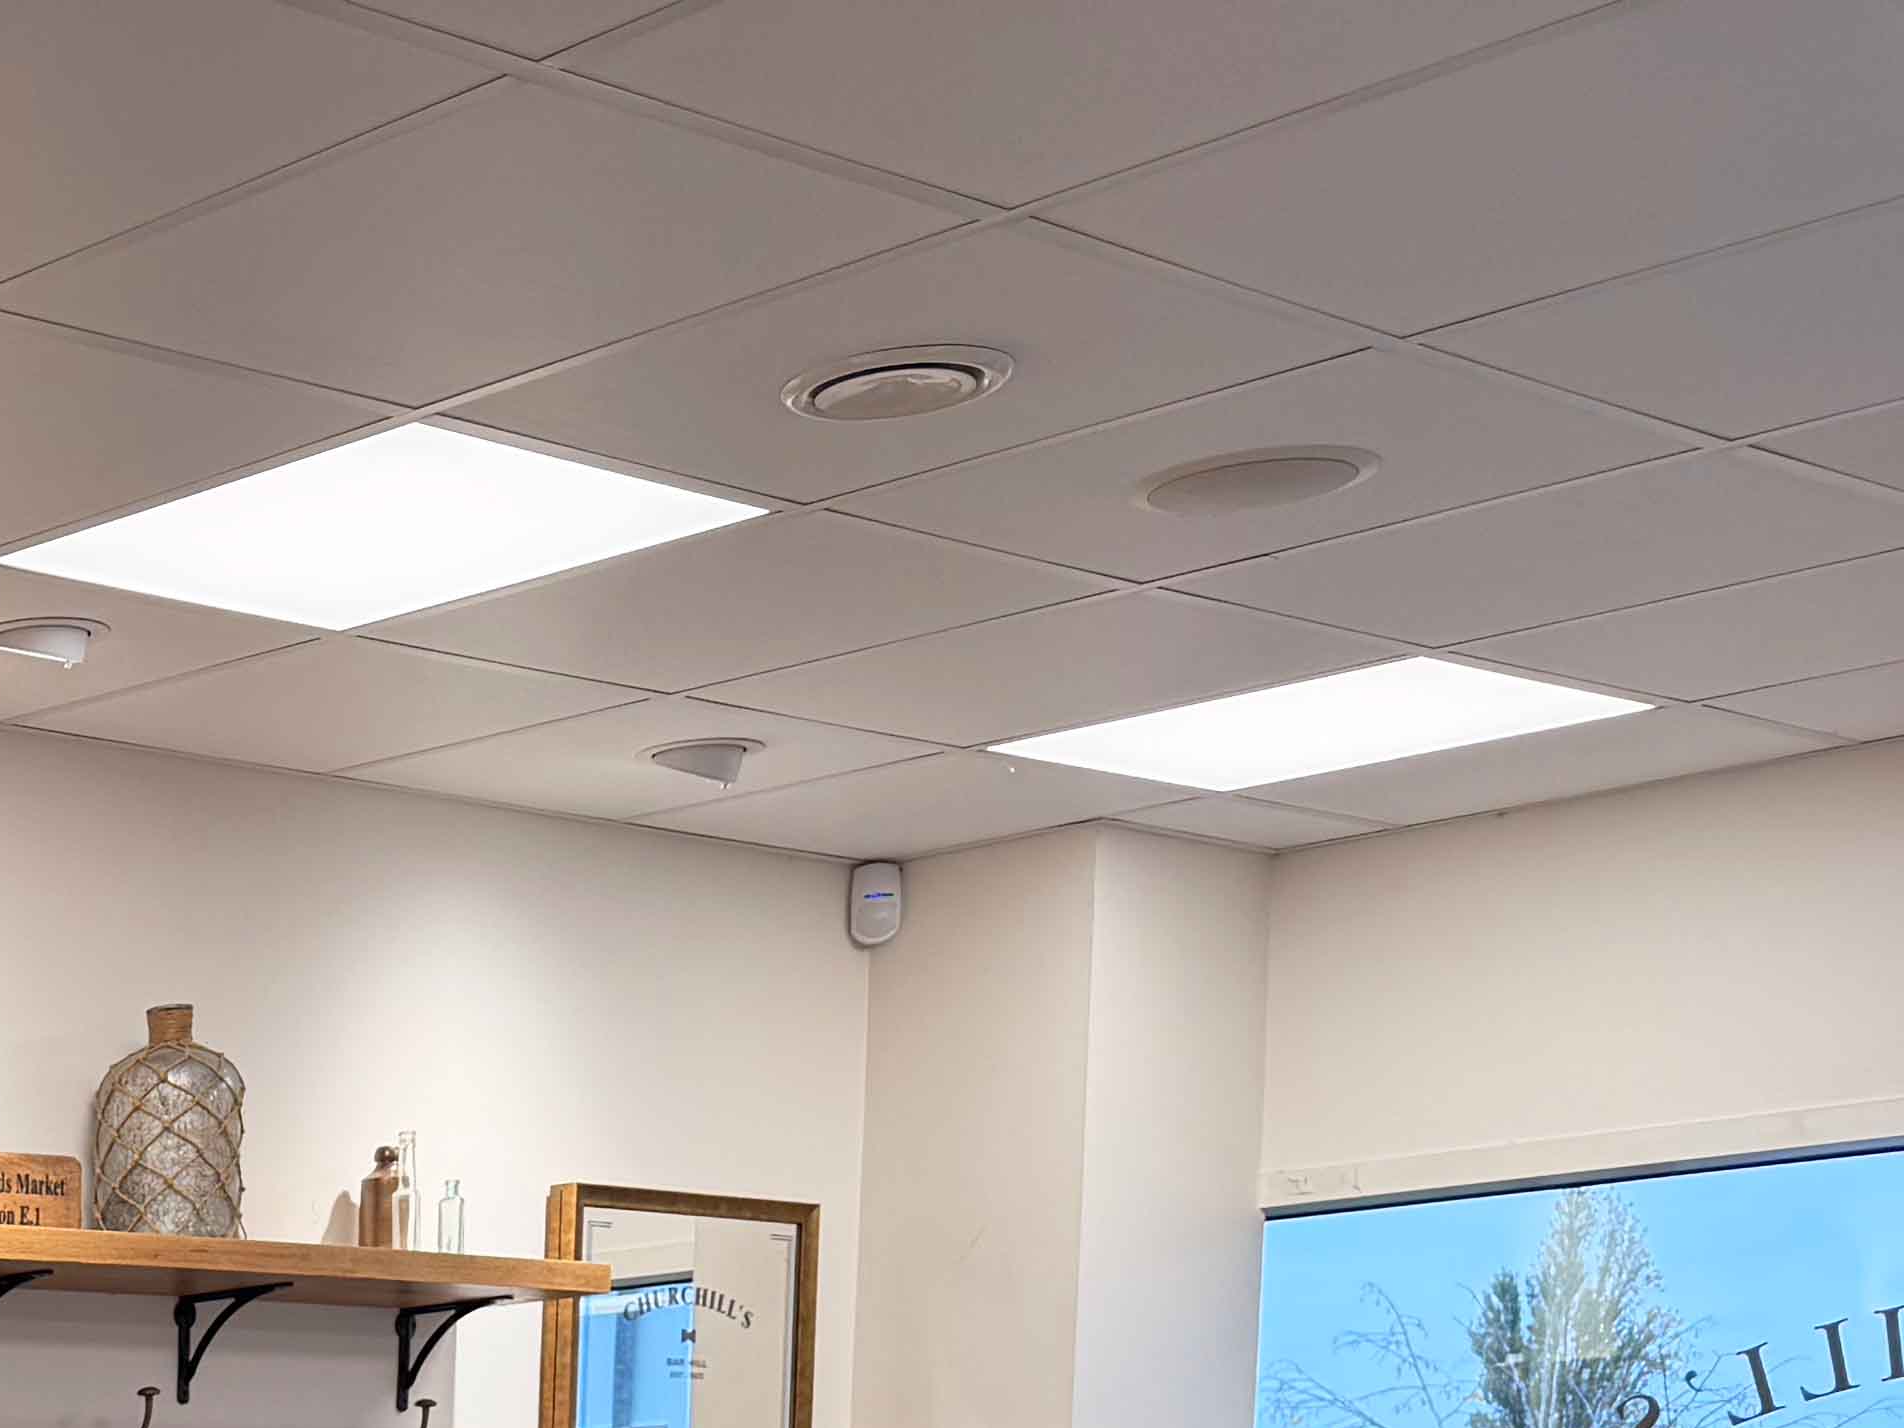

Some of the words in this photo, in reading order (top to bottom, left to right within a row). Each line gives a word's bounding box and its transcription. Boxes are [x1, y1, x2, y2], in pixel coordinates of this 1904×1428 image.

[16, 1173, 66, 1197] Market
[19, 1205, 42, 1227] E.1
[623, 1286, 755, 1329] CHURCHILL'S
